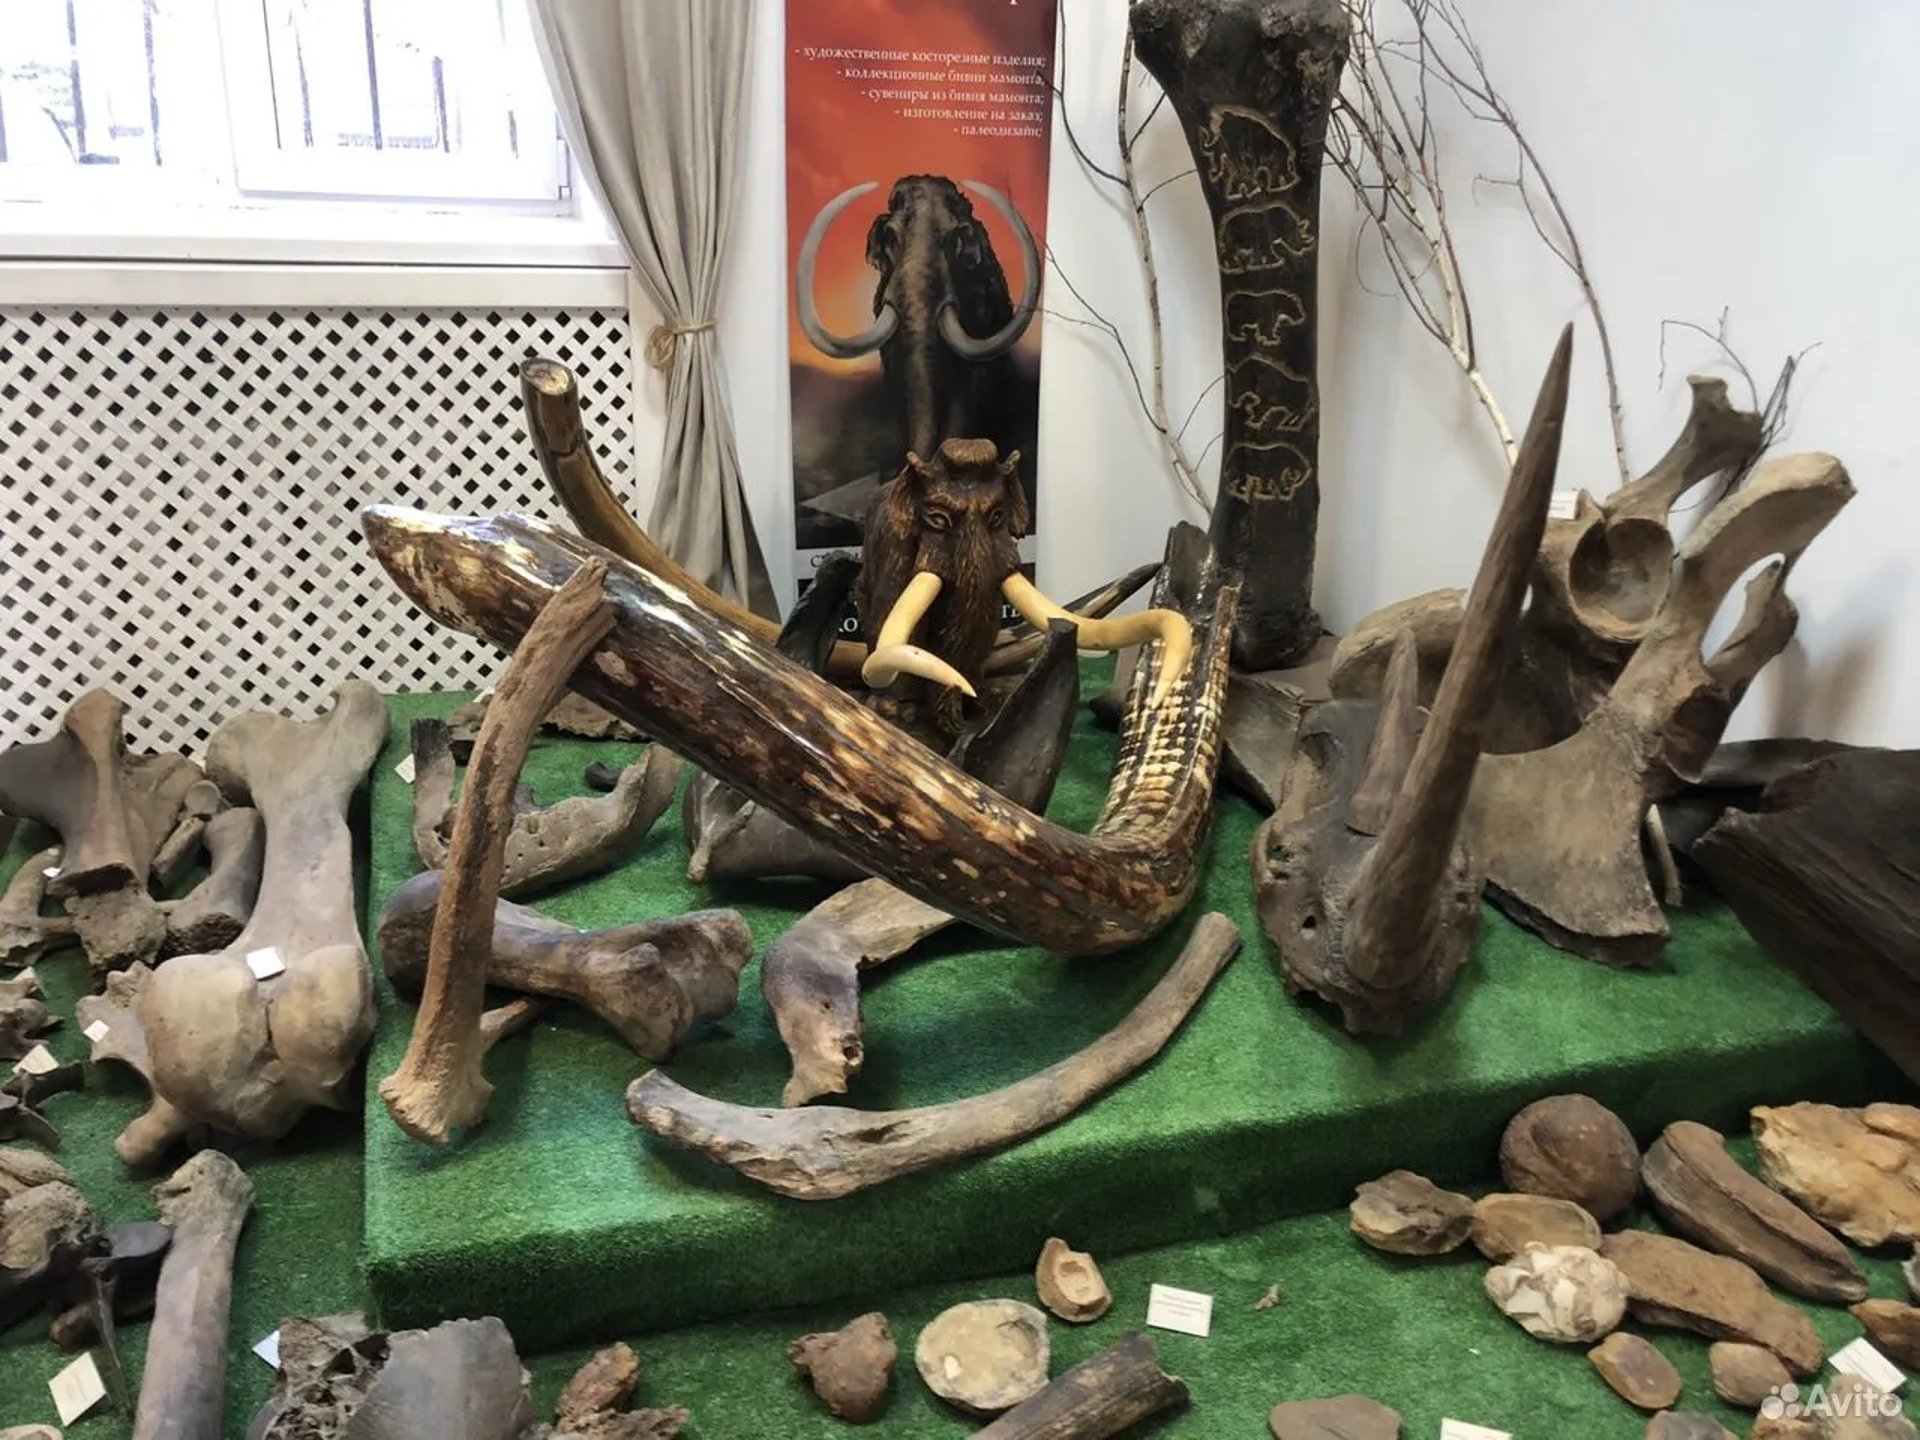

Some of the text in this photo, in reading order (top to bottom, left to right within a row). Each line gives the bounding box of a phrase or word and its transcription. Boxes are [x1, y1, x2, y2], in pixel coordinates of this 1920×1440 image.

[803, 47, 910, 61] художественные
[912, 52, 990, 67] косторезные
[993, 55, 1046, 68] изделия;
[844, 68, 946, 82] коллекционные
[948, 69, 986, 83] бивни
[868, 89, 929, 104] сувениры
[932, 91, 946, 101] из
[949, 89, 985, 102] бивня
[989, 93, 1045, 106] мамонта;
[903, 107, 988, 121] изготовление
[990, 111, 1005, 121] на
[961, 125, 1042, 139] палеодизайн;
